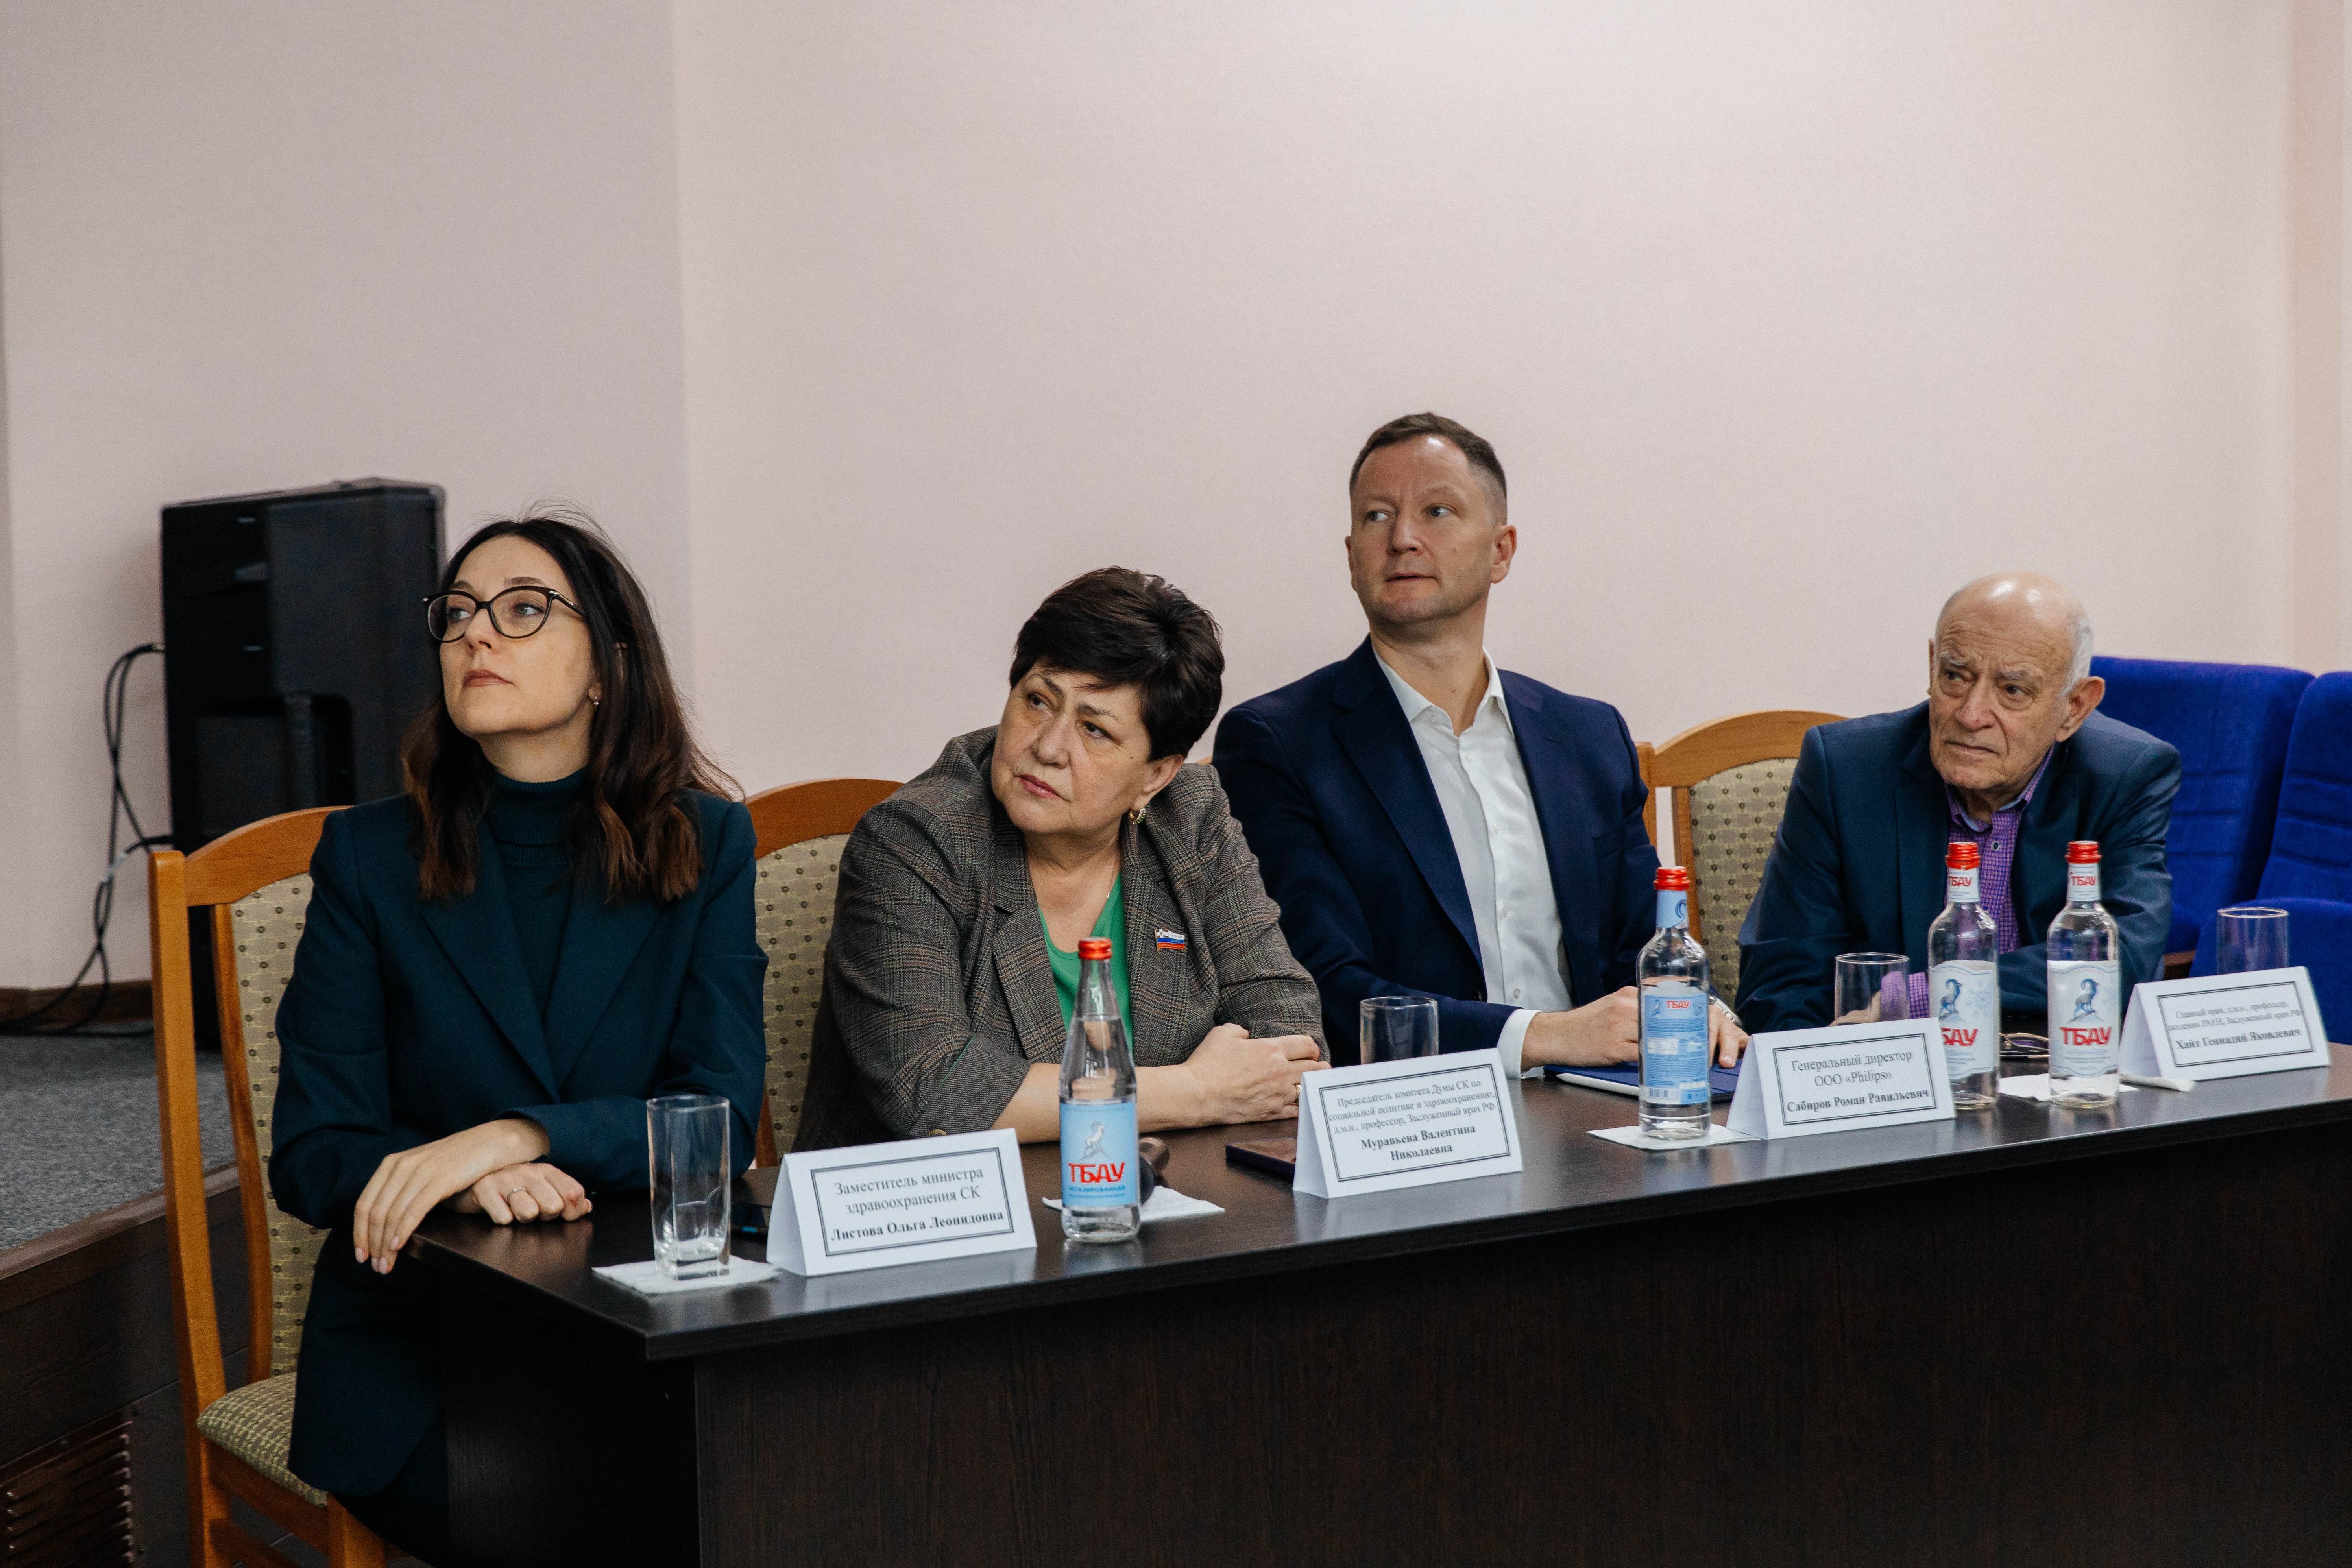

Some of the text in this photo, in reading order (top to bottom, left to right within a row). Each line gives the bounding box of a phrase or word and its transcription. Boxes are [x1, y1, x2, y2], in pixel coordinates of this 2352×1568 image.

[1948, 876, 1973, 887] ТБАУ
[2071, 876, 2096, 886] ТБАУ
[1665, 1000, 1691, 1009] ТБАУ
[2175, 1009, 2206, 1018] Главный
[2226, 1013, 2272, 1024] Заслуженный
[1940, 1027, 1979, 1047] БАУ
[2059, 1026, 2112, 1045] ТБАУ
[2175, 1029, 2300, 1049] Хайт Геннадий Яковлевич
[1791, 1051, 1912, 1072] Генеральный директор
[1814, 1070, 1892, 1087] ООО «Philips»
[1337, 1080, 1481, 1107] Председатель комитета Думы СК по
[1787, 1090, 1929, 1112] Сабиров Роман Равильевич
[1328, 1109, 1375, 1123] социальной
[1377, 1101, 1414, 1114] политике
[1424, 1091, 1495, 1107] здравоохранению,
[1407, 1107, 1461, 1123] Заслуженный
[1463, 1105, 1481, 1116] врач
[1360, 1125, 1476, 1151] Муравьева Валентина
[1390, 1144, 1453, 1160] Николаевна
[834, 1169, 983, 1195] Заместитель министра
[1067, 1162, 1125, 1184] ТБАУ
[845, 1185, 981, 1216] здравоохранения СК
[831, 1211, 1003, 1241] Листова Ольга Леонидовна
